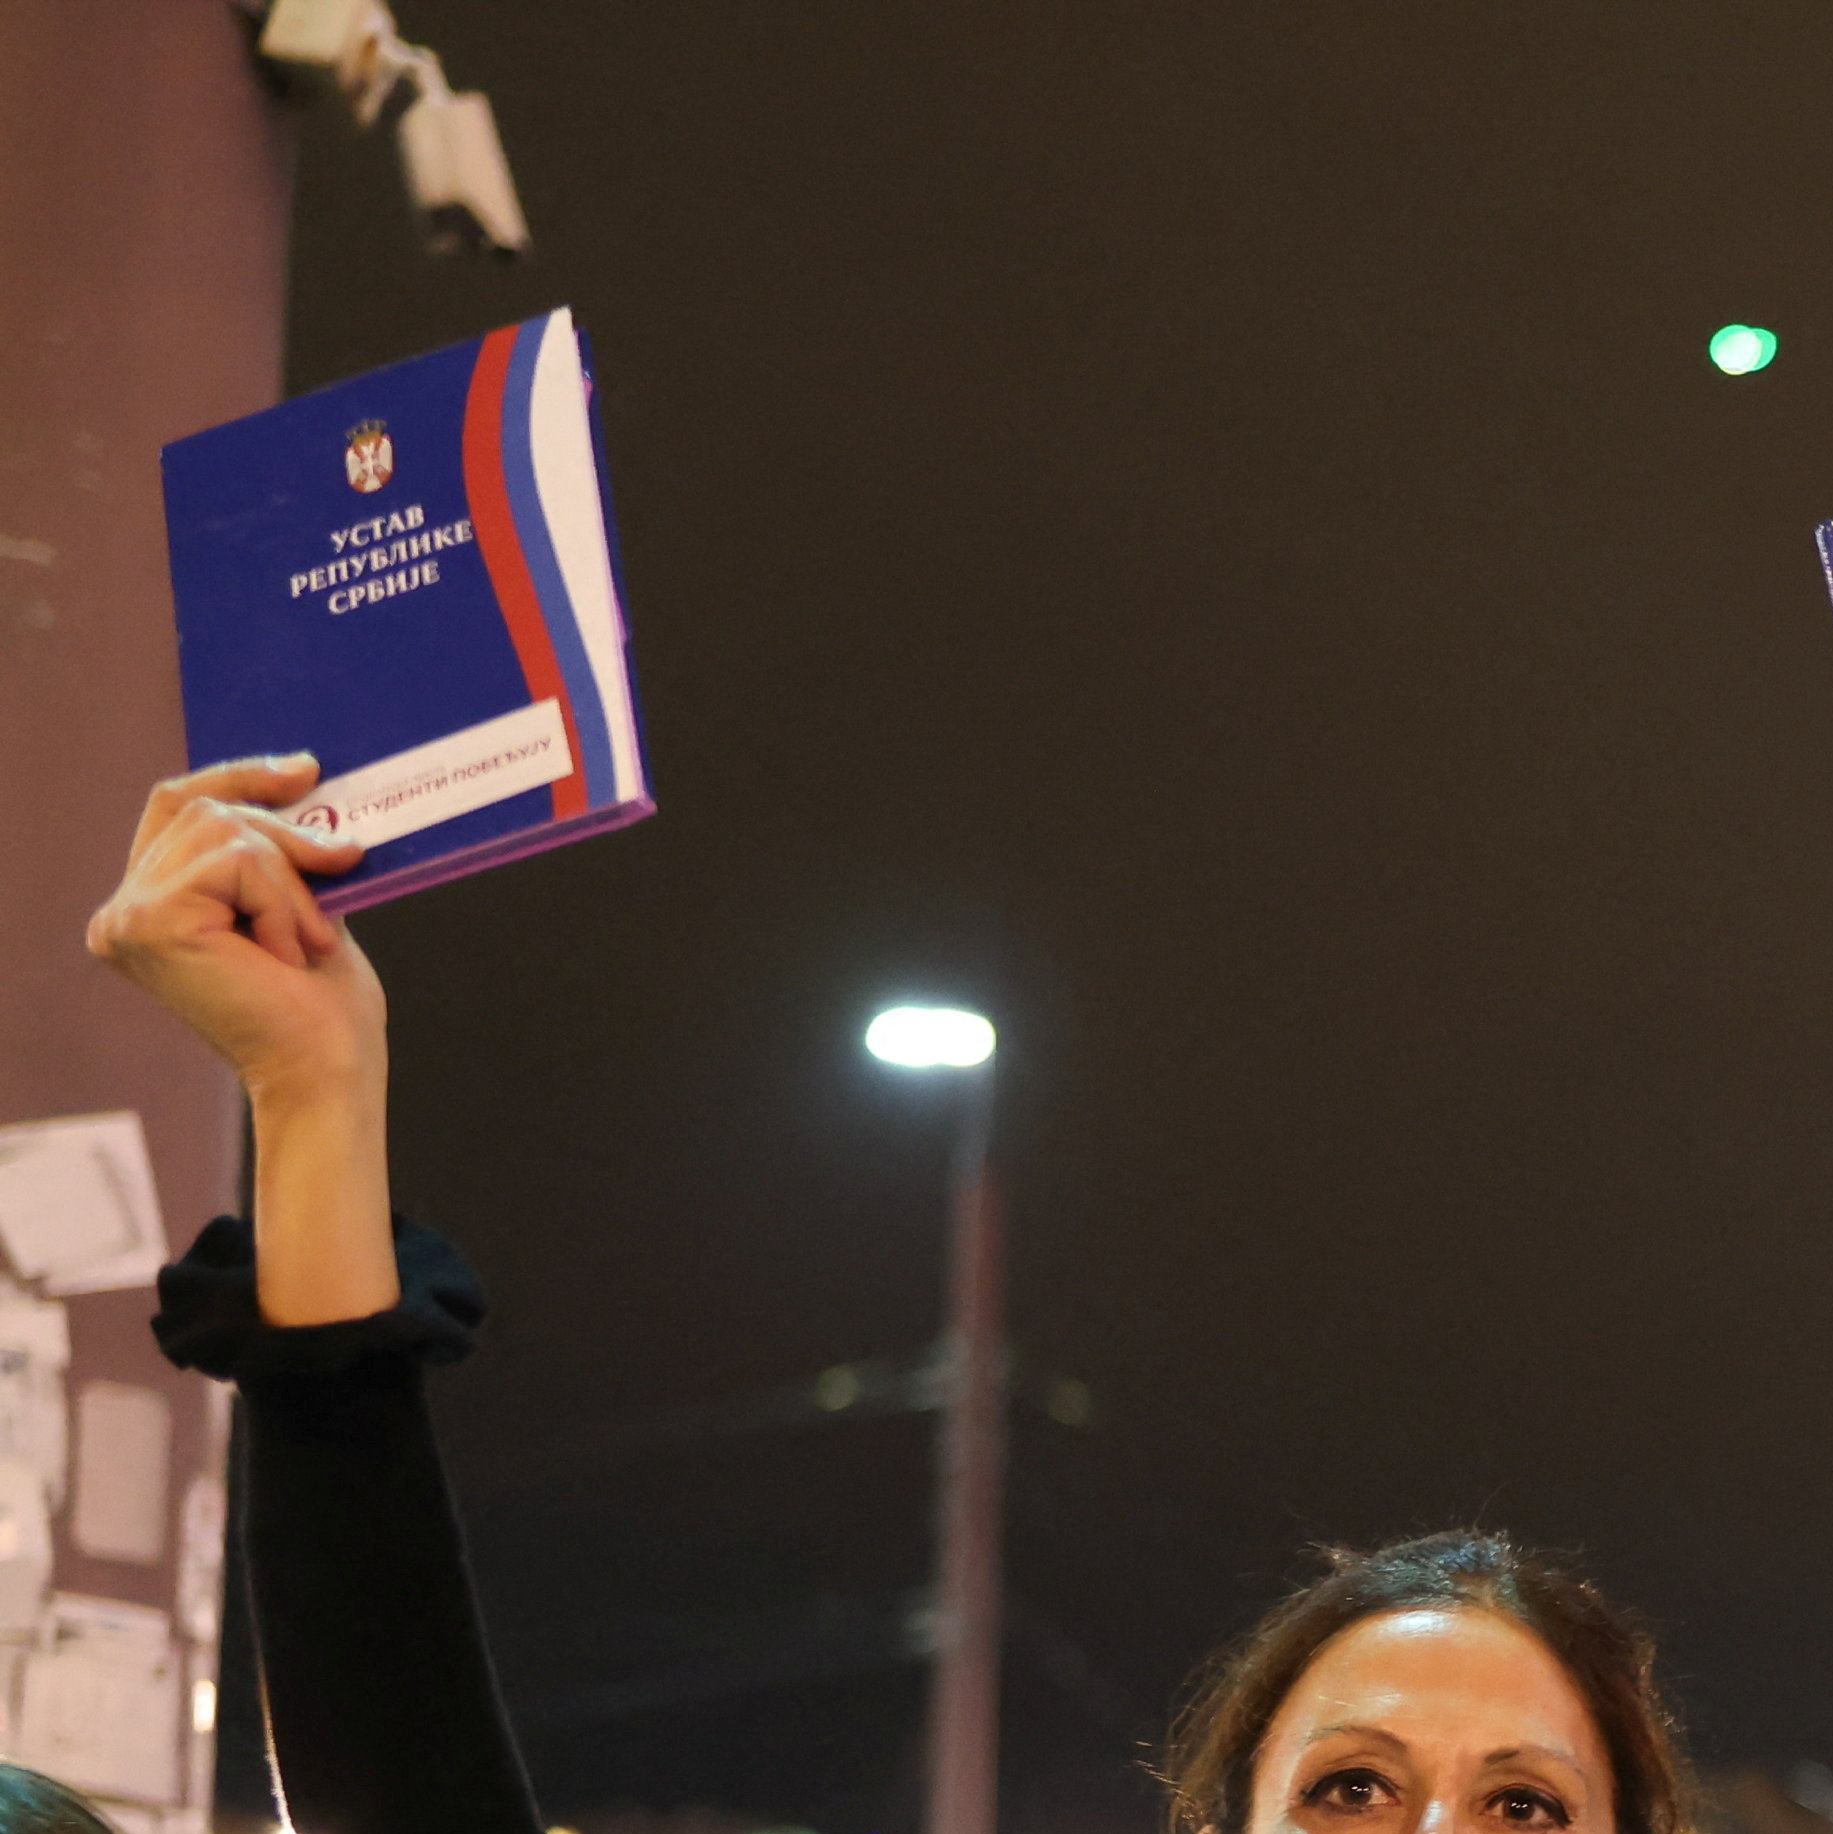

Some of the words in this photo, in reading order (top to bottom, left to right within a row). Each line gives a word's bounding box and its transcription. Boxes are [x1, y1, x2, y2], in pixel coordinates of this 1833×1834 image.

[330, 504, 425, 553] УСТАВ
[289, 519, 475, 598] РЕПУБЛИКЕ
[327, 560, 441, 615] СРБИЈЕ
